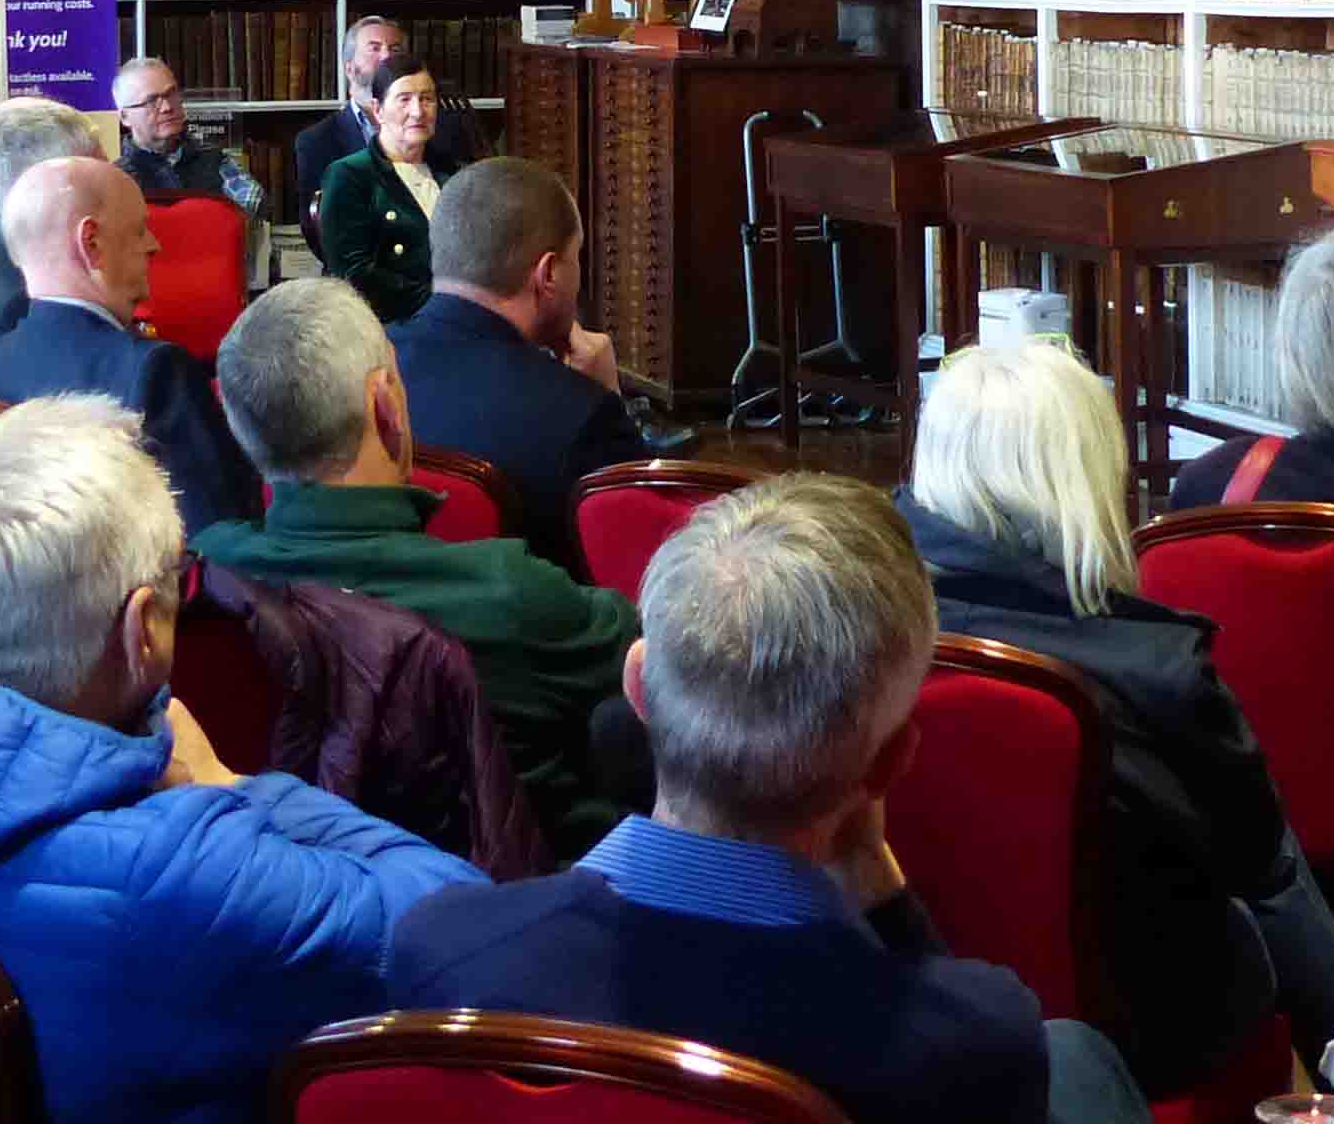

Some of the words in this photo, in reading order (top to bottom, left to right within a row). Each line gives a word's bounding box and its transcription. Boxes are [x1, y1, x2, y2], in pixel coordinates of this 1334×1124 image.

[22, 0, 62, 12] running
[64, 0, 95, 9] costs.
[28, 29, 68, 52] you!
